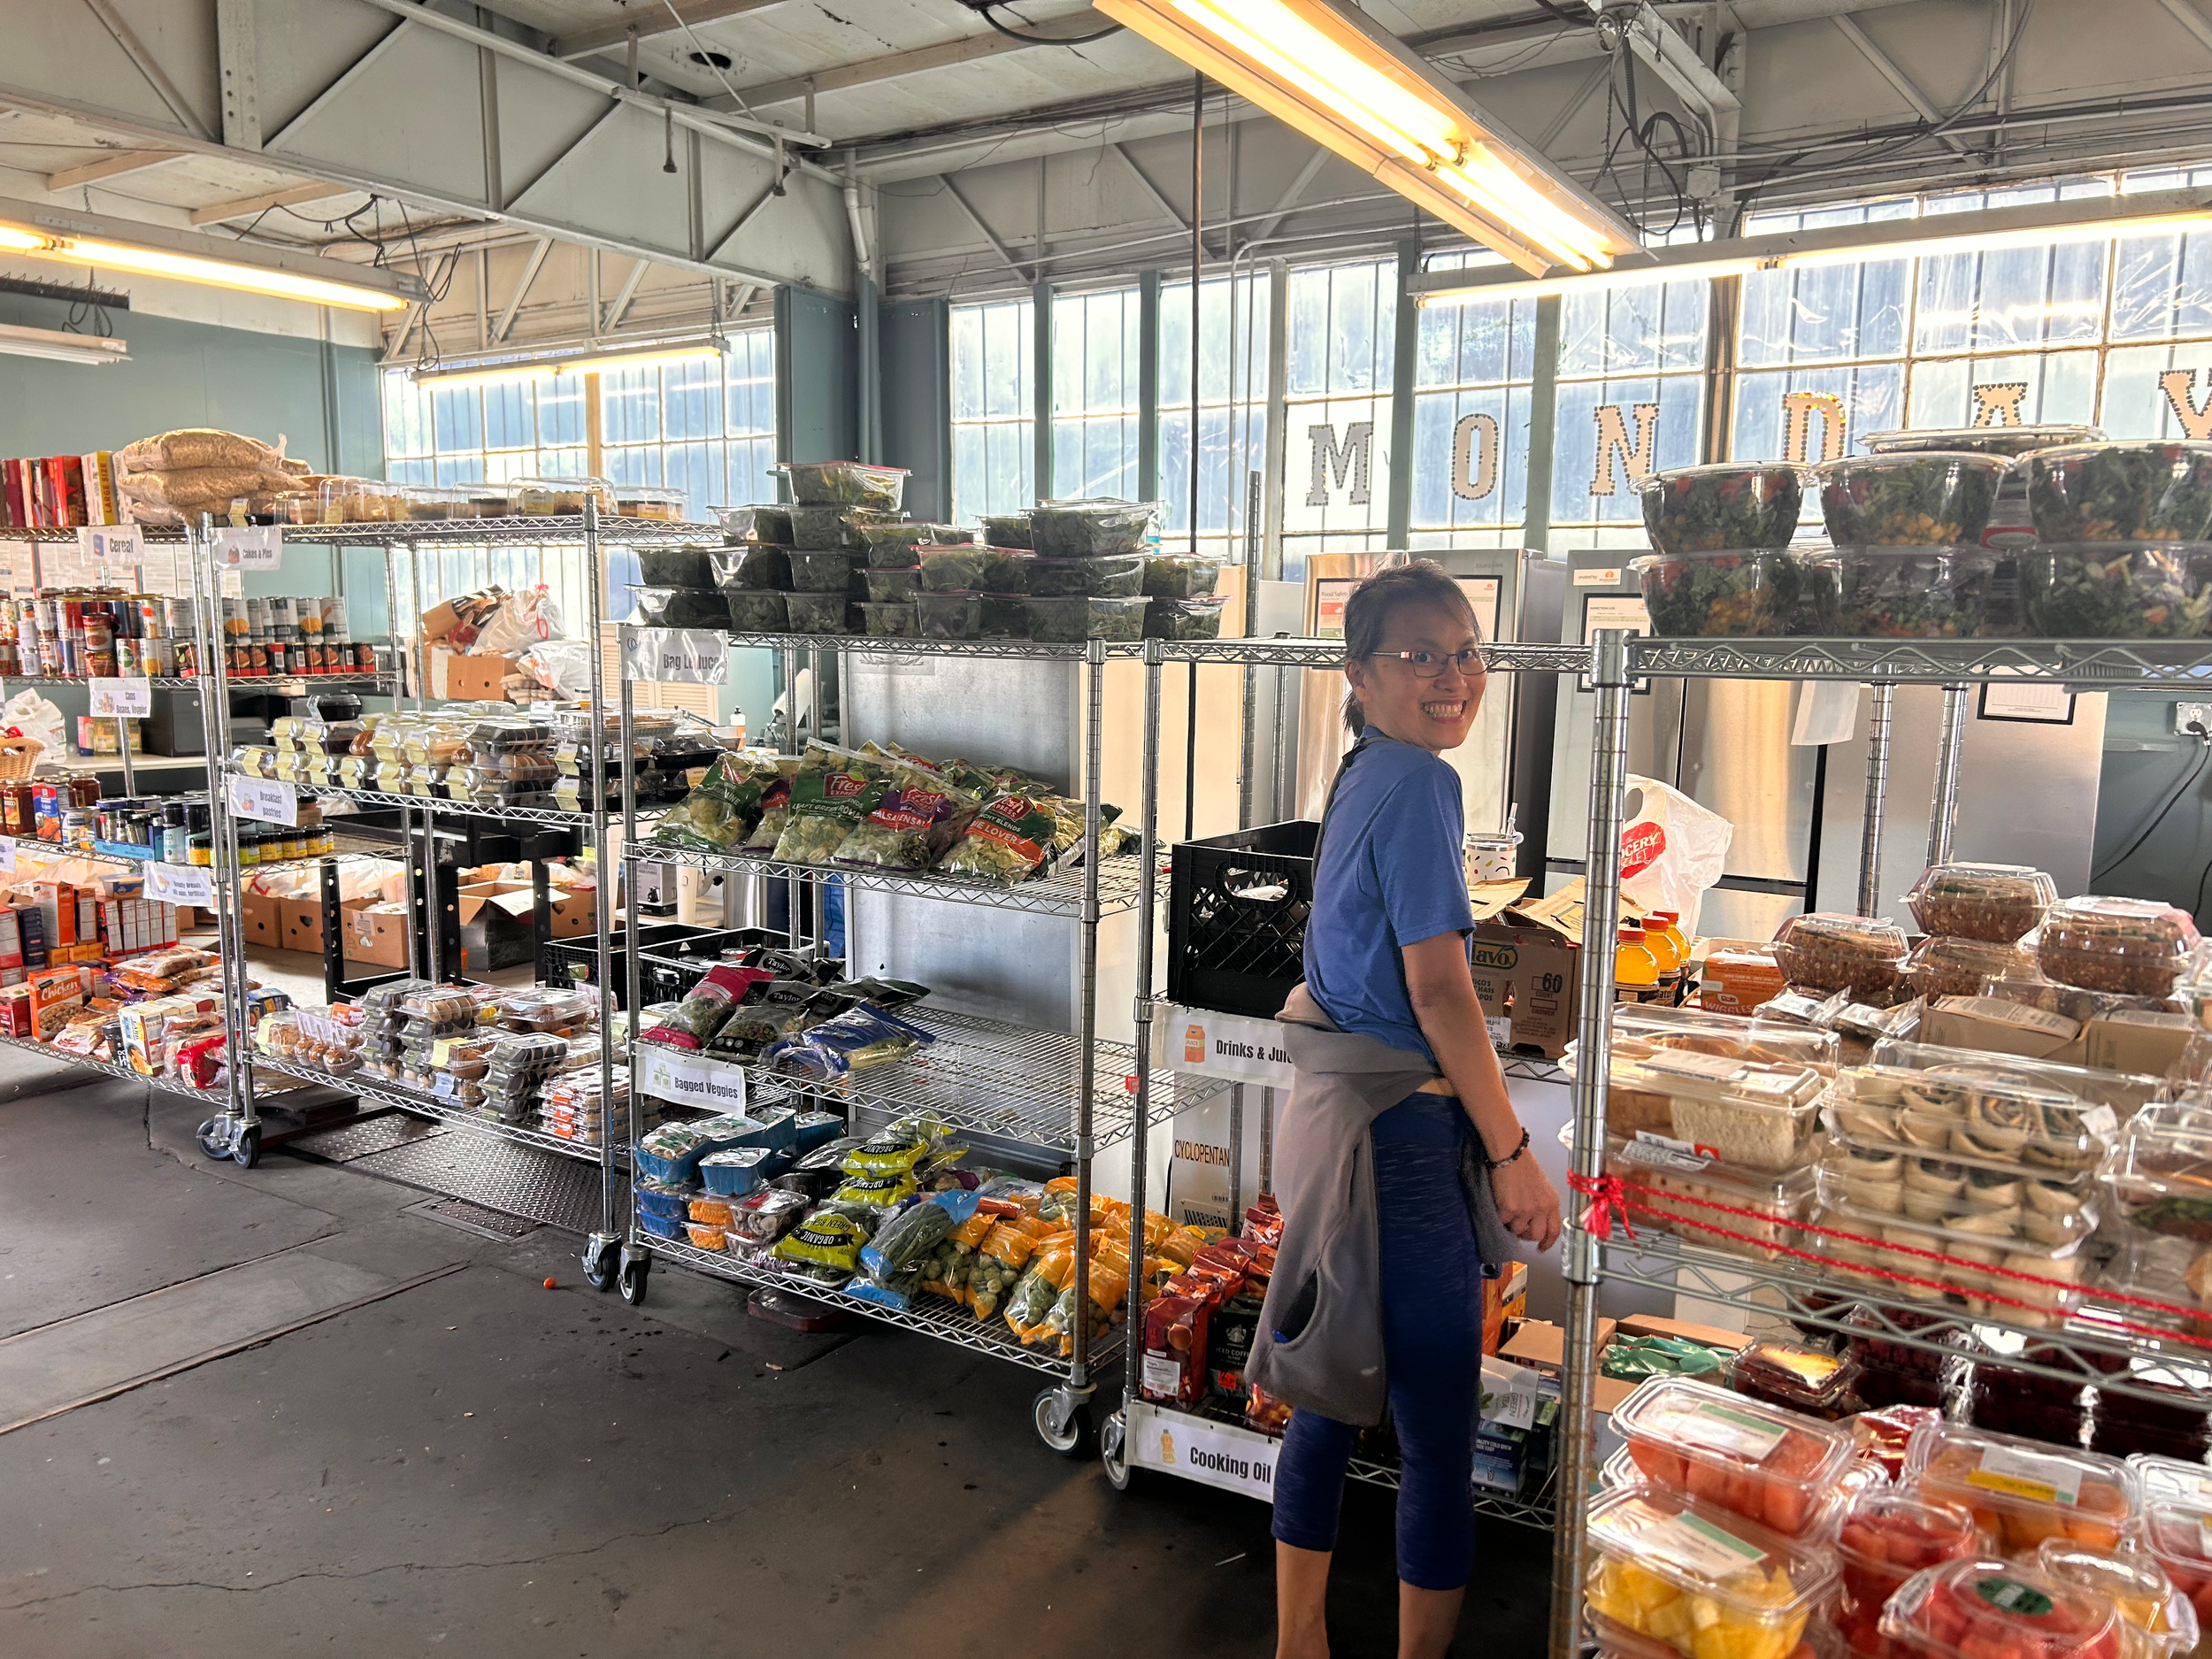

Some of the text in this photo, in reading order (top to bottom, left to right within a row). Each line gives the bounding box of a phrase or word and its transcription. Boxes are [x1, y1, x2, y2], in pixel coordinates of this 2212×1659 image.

[103, 487, 112, 513] LARGE
[110, 538, 134, 553] Cereal
[242, 548, 257, 559] Cakes
[263, 548, 272, 559] Pies
[663, 654, 681, 671] Bag
[125, 692, 135, 701] Cans
[259, 790, 282, 804] Breakfast
[263, 806, 281, 818] pastries
[993, 803, 1018, 818] XPRESS
[995, 818, 1022, 833] BLENDS
[1471, 944, 1512, 965] lavo
[768, 957, 791, 972] Taylor
[1479, 985, 1494, 994] HASS
[1542, 972, 1563, 994] 60
[41, 981, 78, 1001] Chicken
[773, 992, 801, 1002] Taylor
[1531, 1008, 1555, 1017] GROWER
[1704, 1000, 1754, 1015] WIGGLES
[1216, 1039, 1254, 1058] Drinks
[1257, 1046, 1265, 1060] &
[674, 1077, 738, 1099] Bagged Veggies
[830, 1218, 851, 1233] GREEN
[800, 1231, 834, 1245] ORGANIC
[1502, 1395, 1510, 1409] TEA
[1509, 1392, 1519, 1417] GREEN
[1190, 1447, 1271, 1483] Cooking Oil
